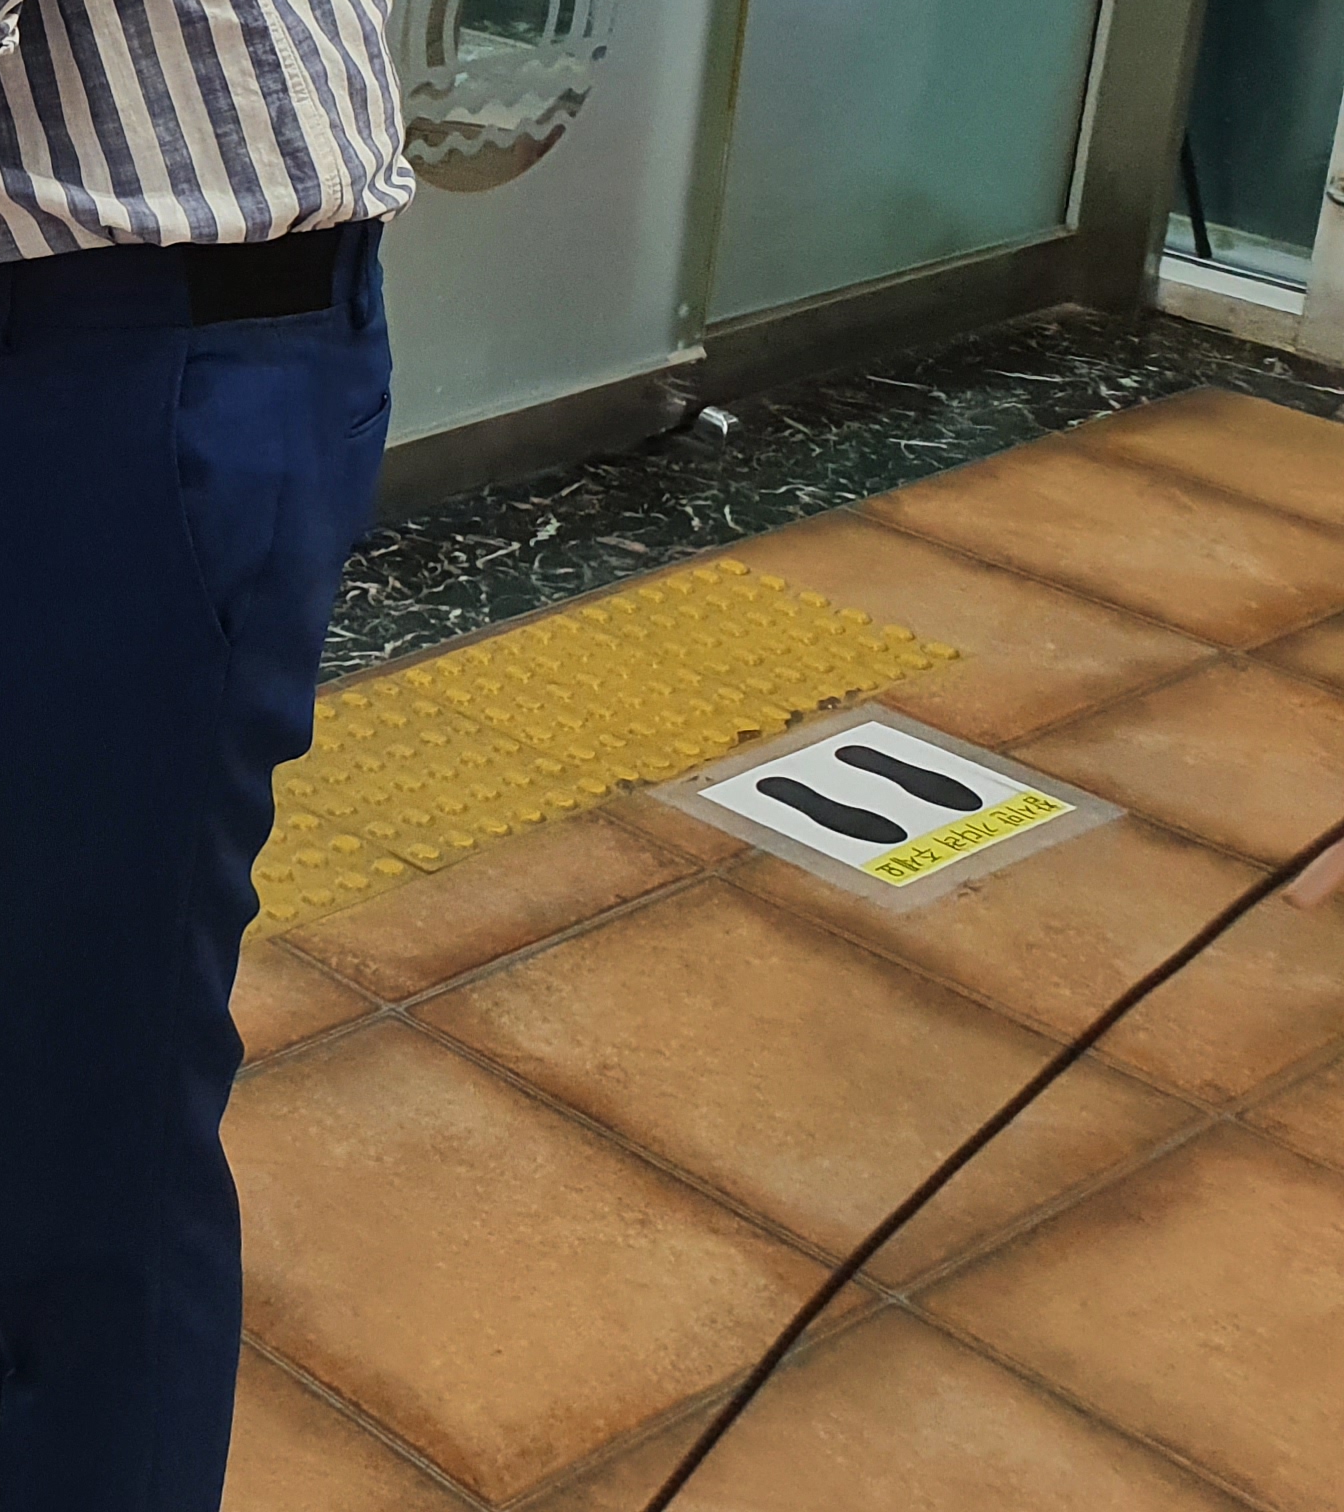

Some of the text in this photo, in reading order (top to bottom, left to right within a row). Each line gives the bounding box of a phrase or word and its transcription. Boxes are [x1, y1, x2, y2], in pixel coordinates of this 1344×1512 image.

[874, 795, 1058, 878] 잠시만 기다려 주세요
